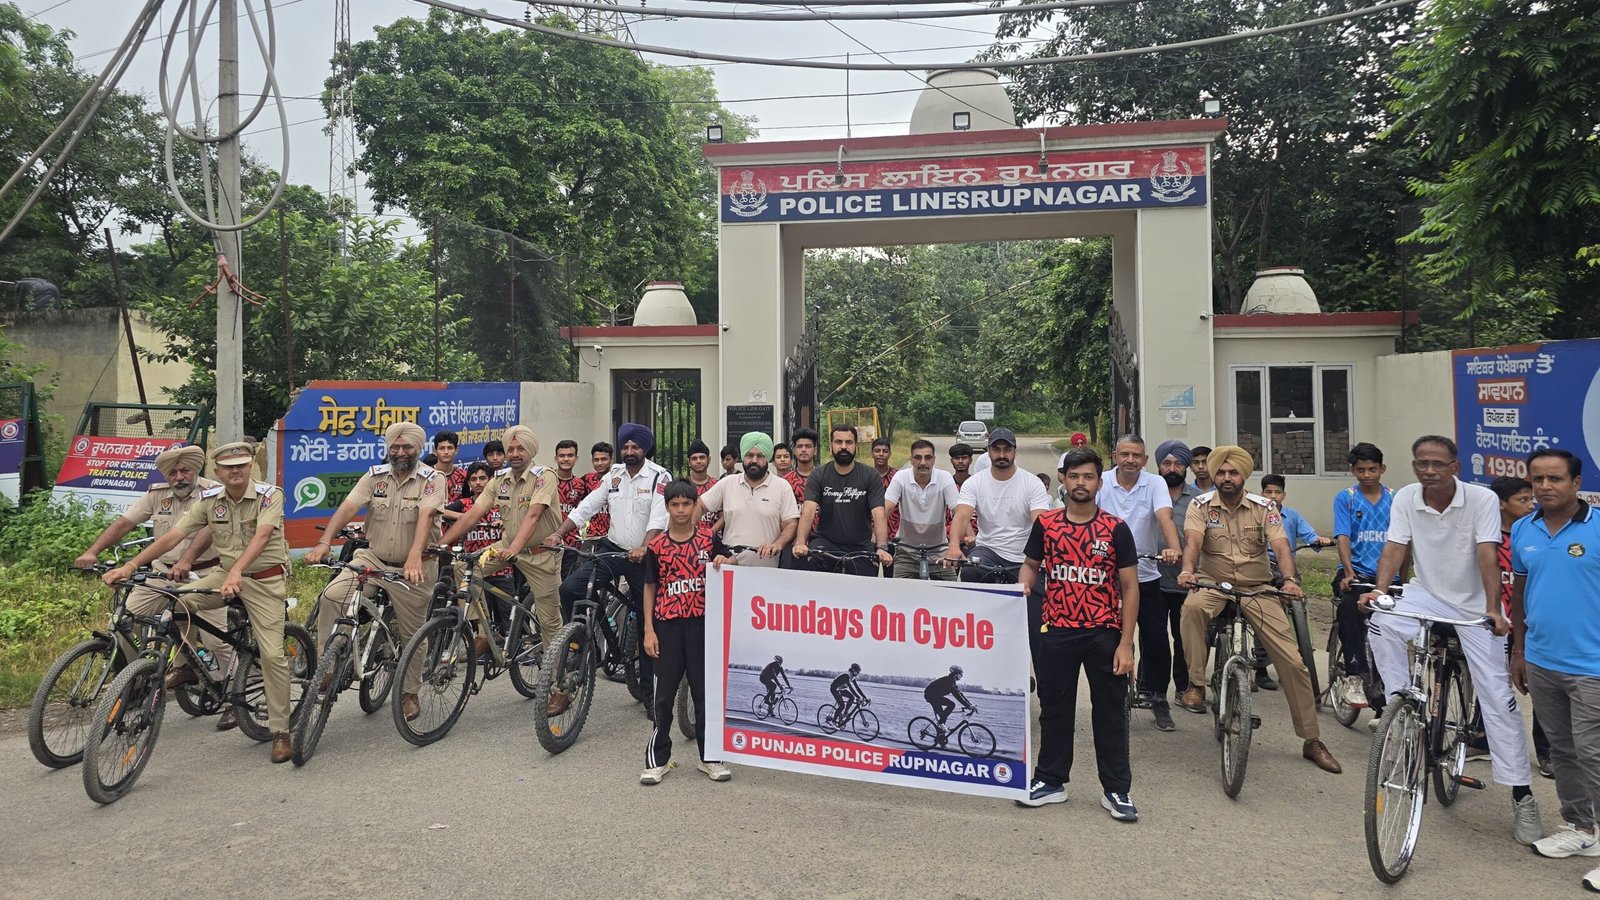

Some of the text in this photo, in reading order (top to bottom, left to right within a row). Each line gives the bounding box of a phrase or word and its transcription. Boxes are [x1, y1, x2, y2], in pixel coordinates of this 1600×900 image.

[780, 195, 882, 216] POLICE
[1478, 381, 1524, 401] ਸਾਵਧਾਨ
[318, 396, 419, 436] ਸੇਫ ਪੰਜਾਬ
[91, 442, 134, 456] ਰੂਪਨਗਰ
[89, 469, 149, 480] TRAFFIC POLICE
[1488, 457, 1527, 479] 1930
[91, 479, 137, 490] (RUPNAGAR)
[1092, 540, 1109, 551] JS
[1358, 530, 1389, 542] HOCKE
[698, 550, 709, 560] JS
[1051, 564, 1107, 585] HOCKEY
[751, 595, 994, 650] Sundays On Cycle
[751, 737, 990, 779] PUNJAB POLICE RUPNAGAR
